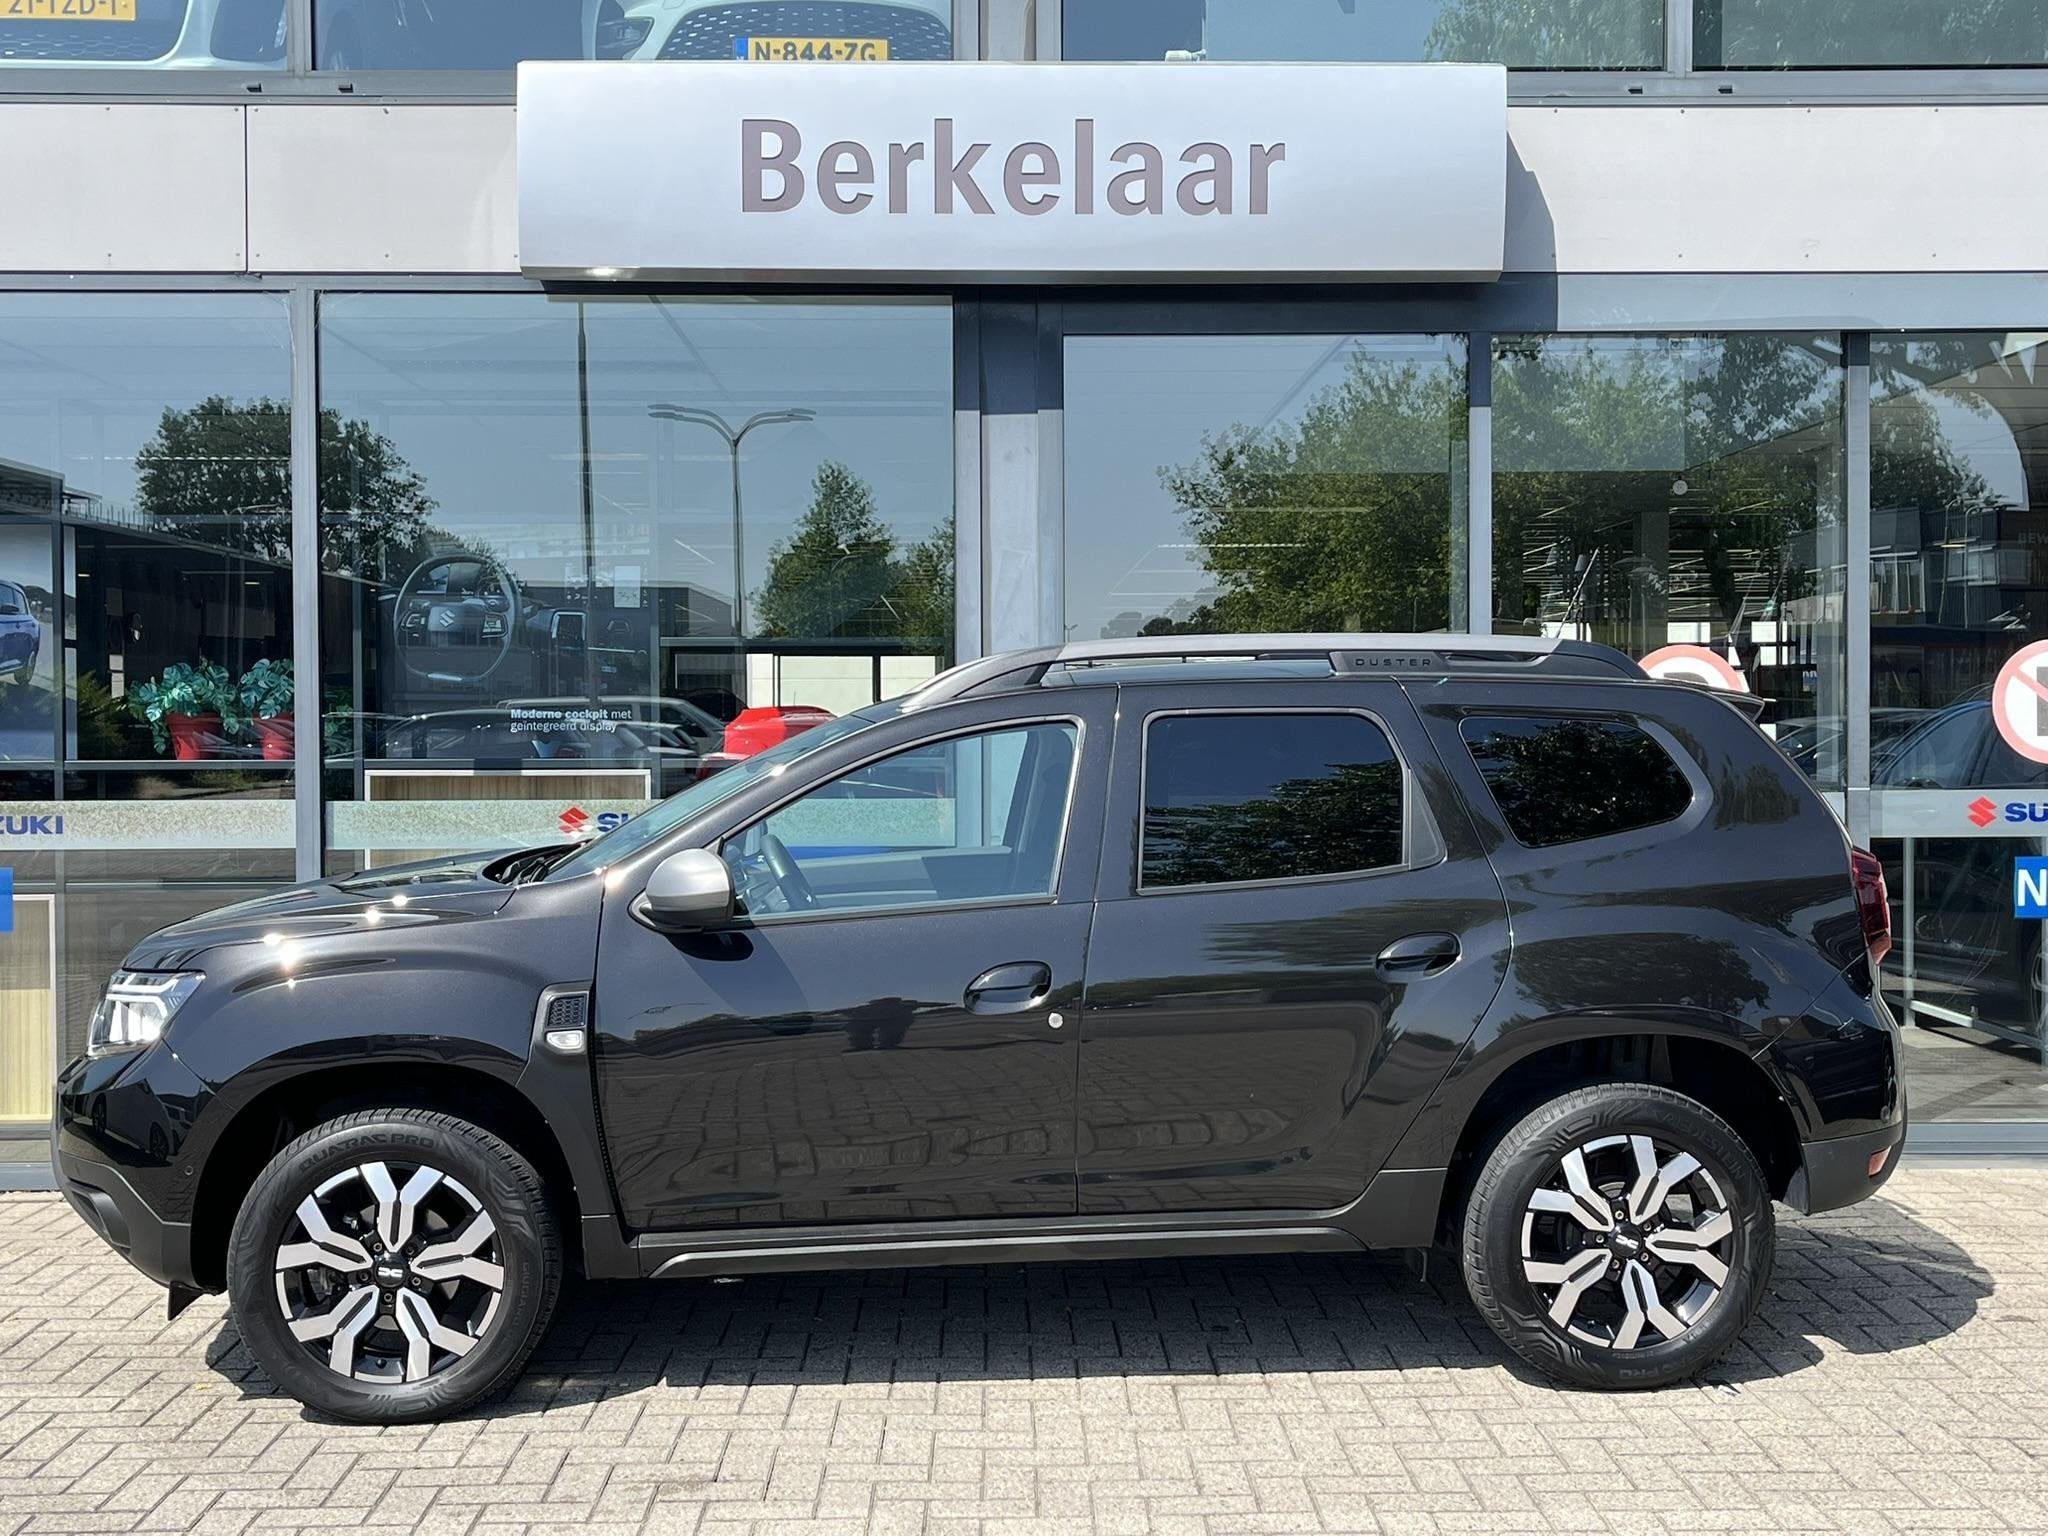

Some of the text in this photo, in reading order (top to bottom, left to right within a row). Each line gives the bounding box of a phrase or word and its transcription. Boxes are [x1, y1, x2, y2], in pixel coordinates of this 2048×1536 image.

[741, 118, 1286, 216] Berkelaar
[1355, 658, 1431, 667] DUSTER
[510, 709, 632, 720] Moderne cockpit met
[580, 721, 617, 732] display
[0, 815, 63, 834] UKI
[2017, 868, 2048, 907] N
[391, 1133, 435, 1149] PRO
